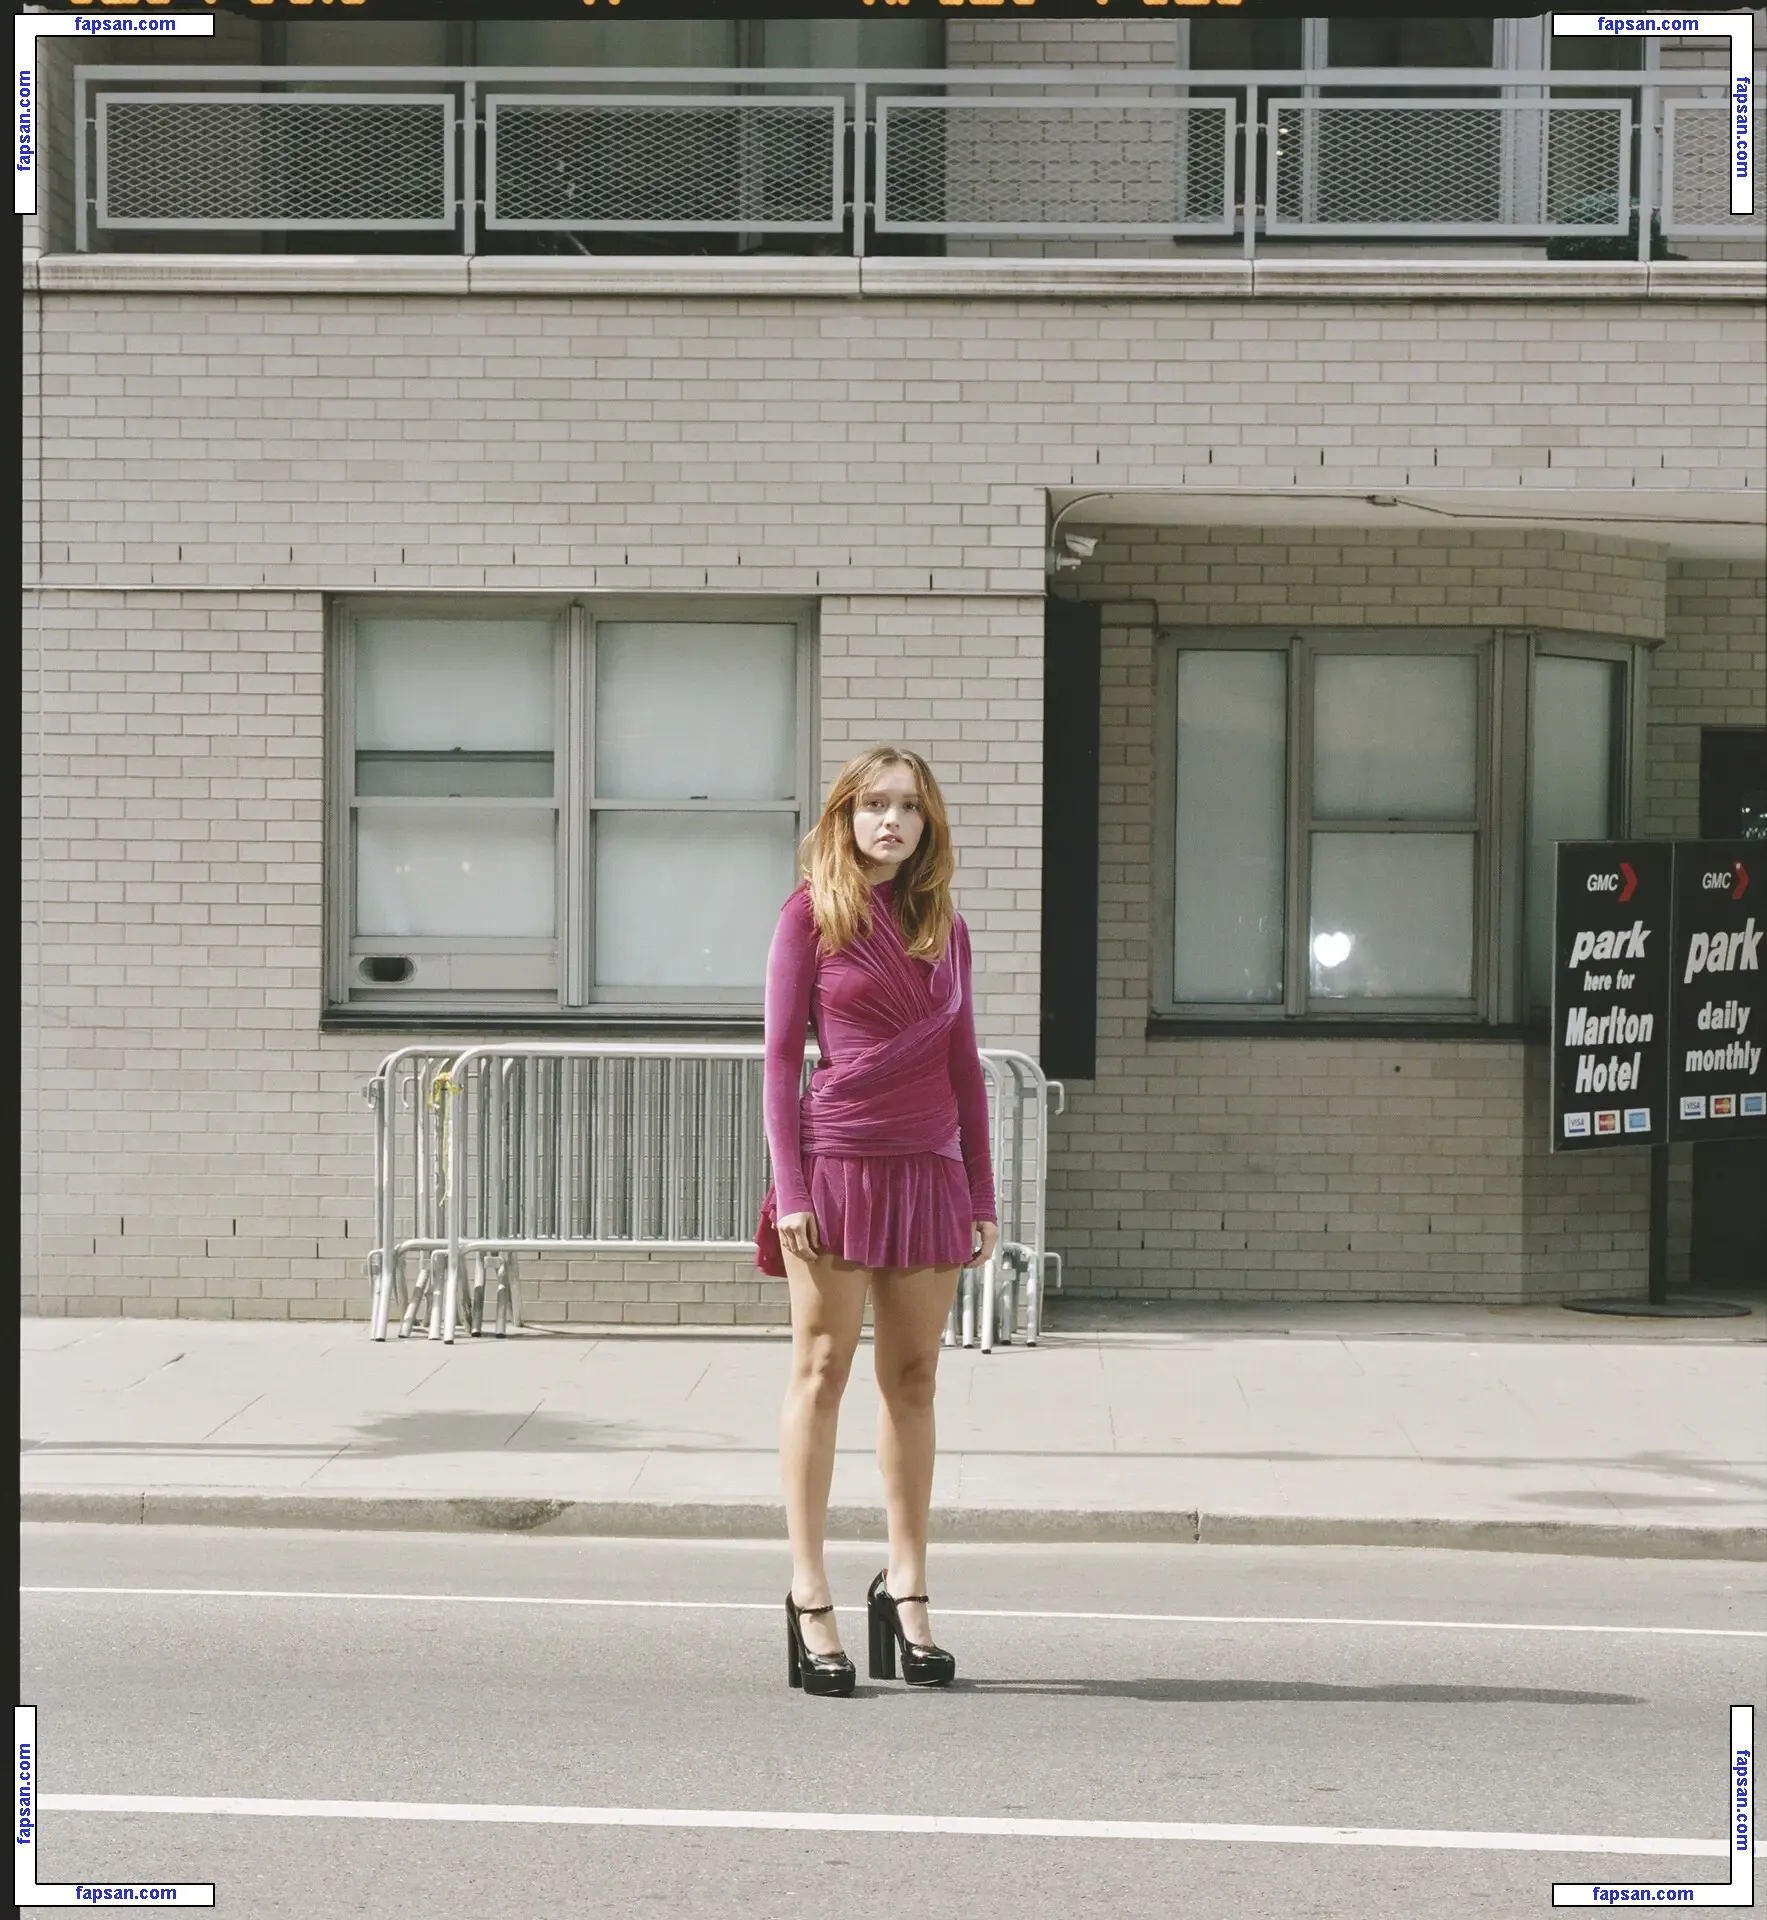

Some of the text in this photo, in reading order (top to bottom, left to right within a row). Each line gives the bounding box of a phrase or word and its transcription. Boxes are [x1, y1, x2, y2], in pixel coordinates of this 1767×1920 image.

[1587, 873, 1619, 892] GMC
[1702, 871, 1732, 890] GMC
[1569, 920, 1652, 969] park
[1684, 917, 1764, 984] park
[1583, 968, 1636, 991] here for
[1565, 1005, 1654, 1047] Marlton
[1697, 1000, 1751, 1035] daily
[1575, 1051, 1642, 1094] Hotel
[1685, 1040, 1762, 1075] monthly
